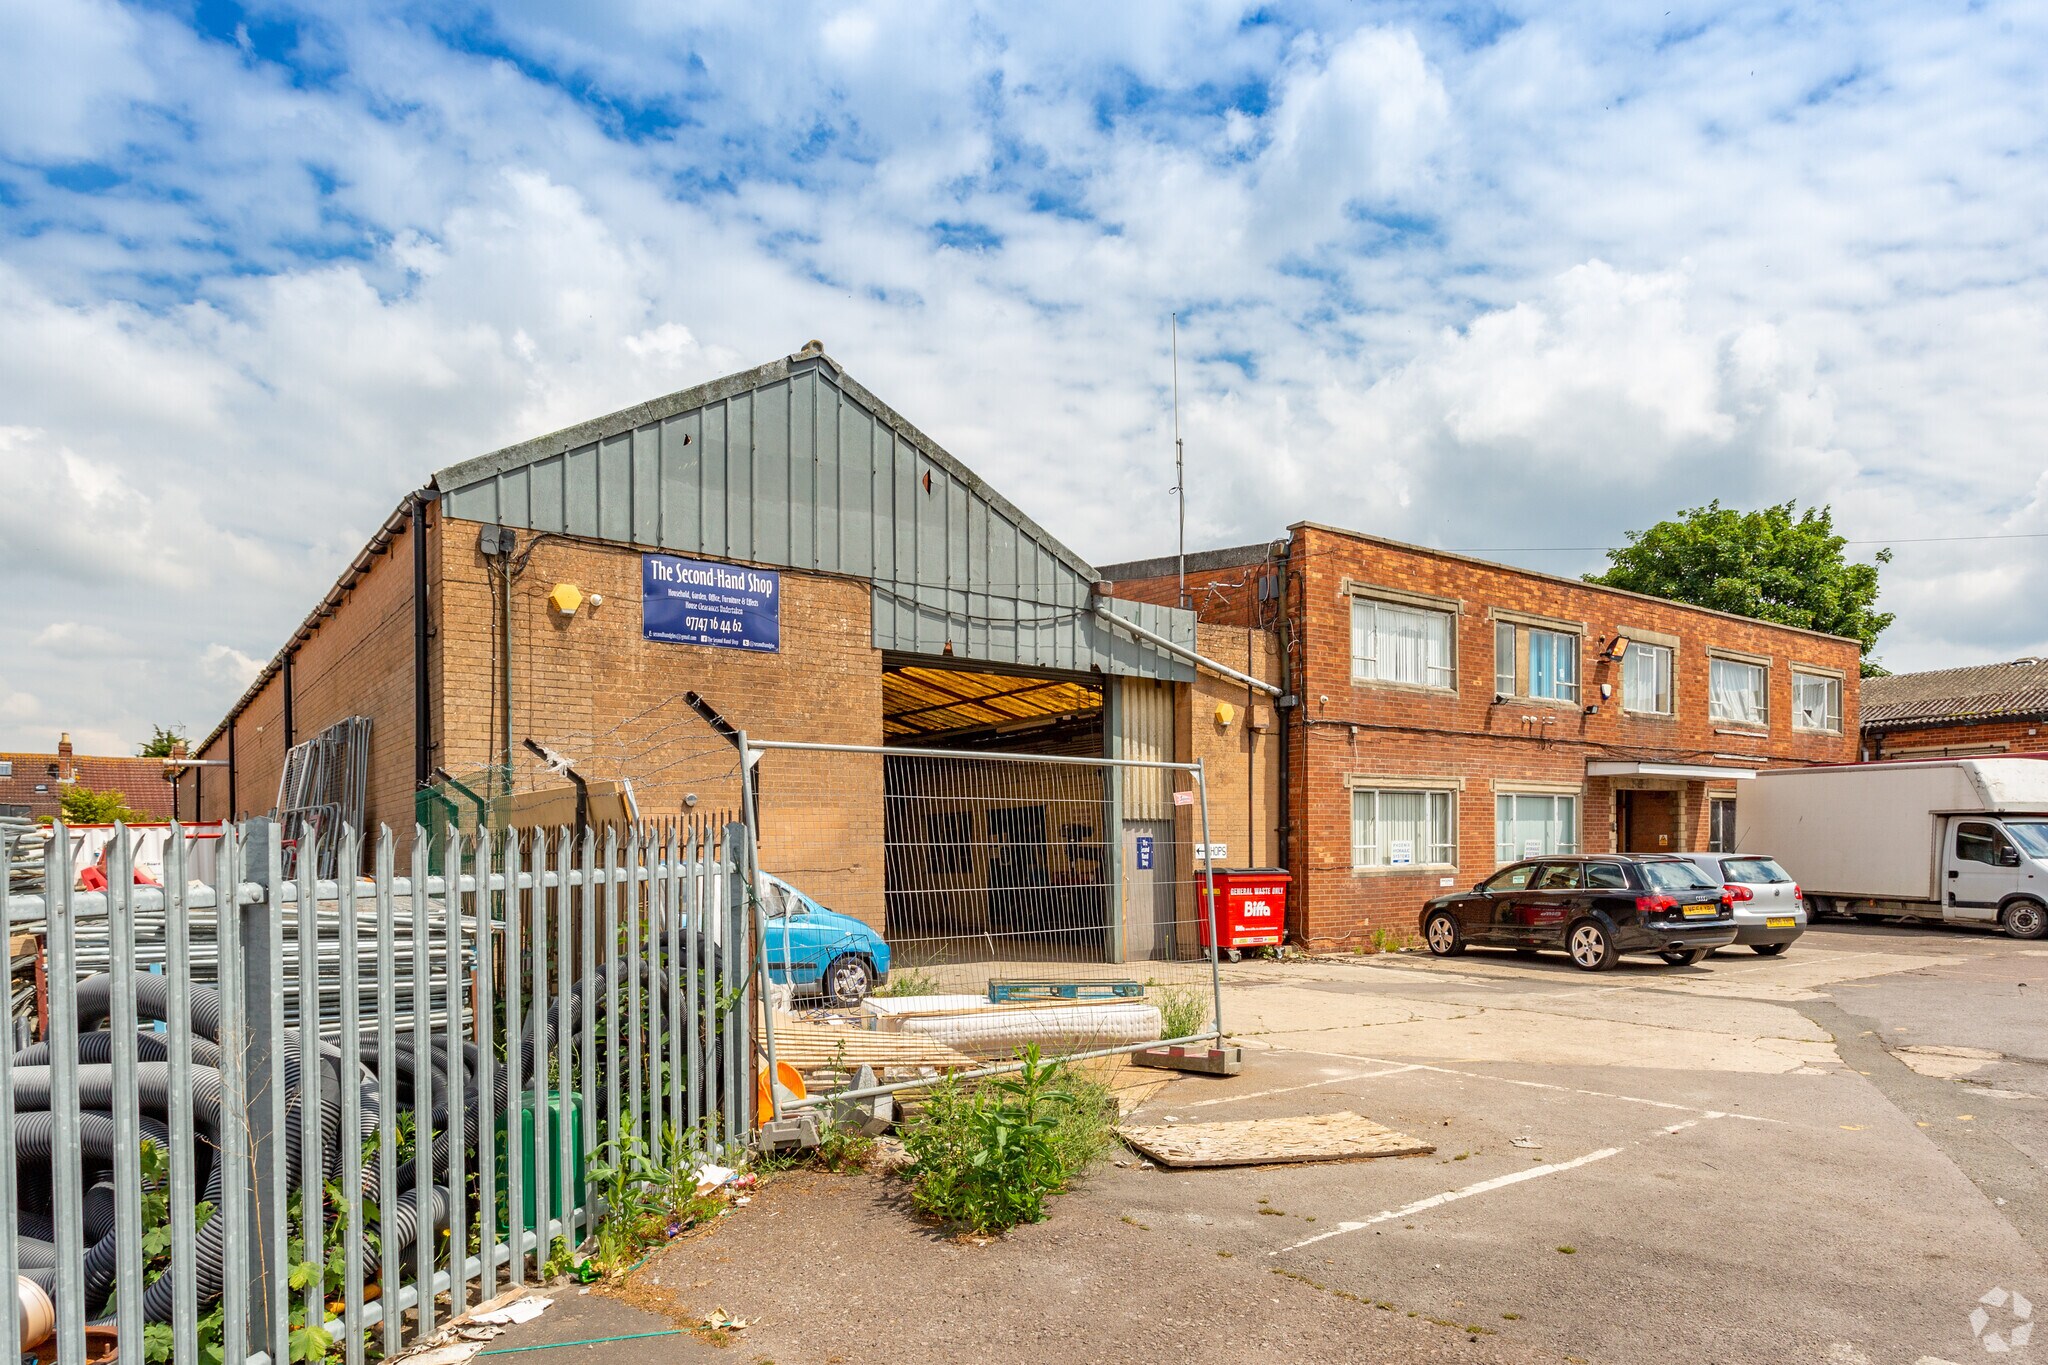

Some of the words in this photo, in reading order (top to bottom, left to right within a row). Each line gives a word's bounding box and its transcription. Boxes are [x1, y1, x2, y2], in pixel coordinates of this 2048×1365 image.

[651, 560, 673, 581] The
[747, 573, 773, 598] Shop
[686, 616, 708, 632] 07747
[709, 616, 718, 630] 16
[719, 620, 731, 634] 44
[733, 619, 743, 632] 62
[1210, 846, 1226, 856] HOPS
[1254, 887, 1271, 895] WASTE
[1272, 887, 1284, 895] ONLY
[1244, 900, 1271, 917] Biffa
